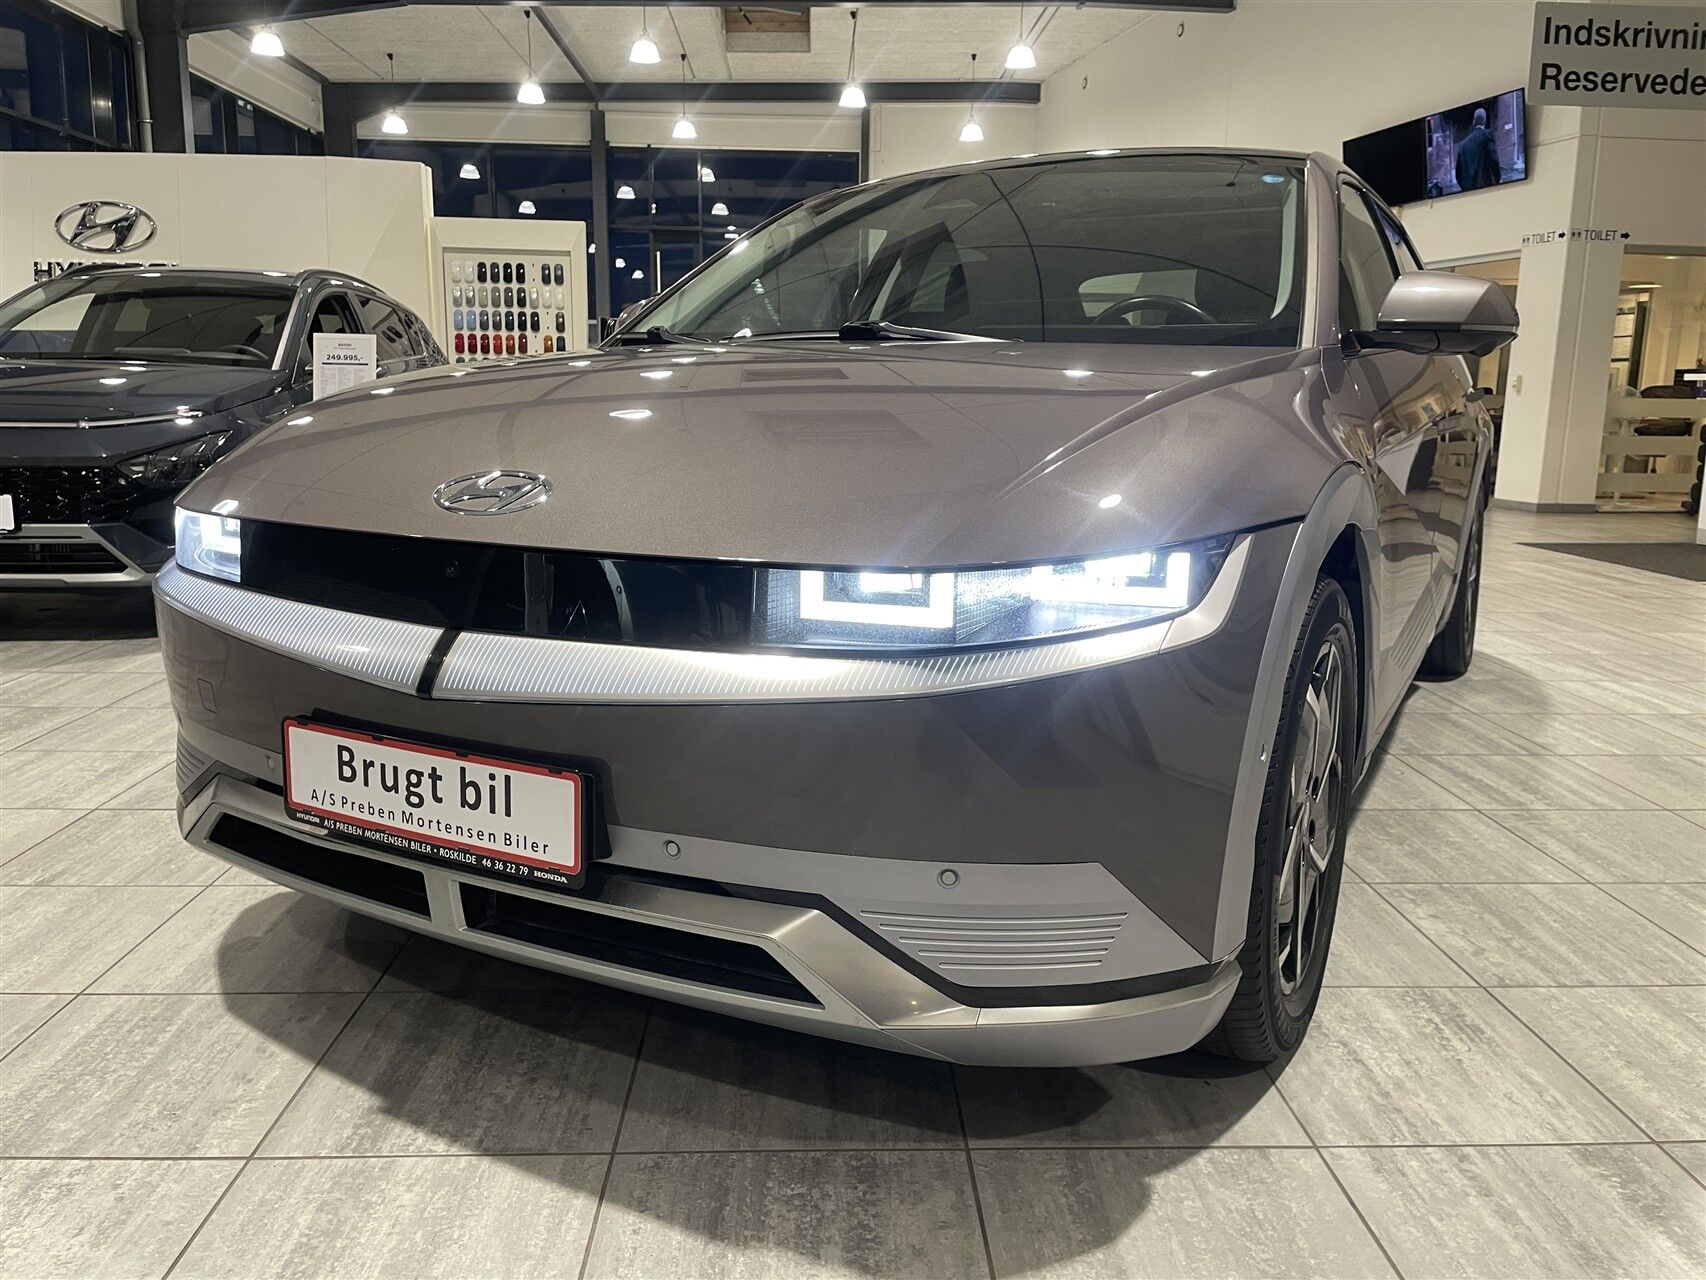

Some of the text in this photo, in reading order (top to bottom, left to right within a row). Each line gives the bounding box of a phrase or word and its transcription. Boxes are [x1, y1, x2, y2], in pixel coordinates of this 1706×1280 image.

[1539, 63, 1706, 96] Reservede
[1531, 231, 1557, 245] TOILET
[1584, 229, 1618, 241] TOILET
[337, 744, 511, 818] Brugt bil
[310, 788, 549, 855] A/S Preben Mortensen Biler
[324, 818, 335, 829] A/S
[335, 822, 363, 836] PREBEN
[364, 830, 409, 848] MORTENSEN
[410, 841, 432, 854] BILER
[440, 847, 477, 865] ROSKILDE
[482, 857, 492, 868] 46
[494, 861, 504, 871] 36
[506, 864, 517, 874] 22
[519, 866, 529, 876] 79
[533, 870, 569, 884] HONDA
